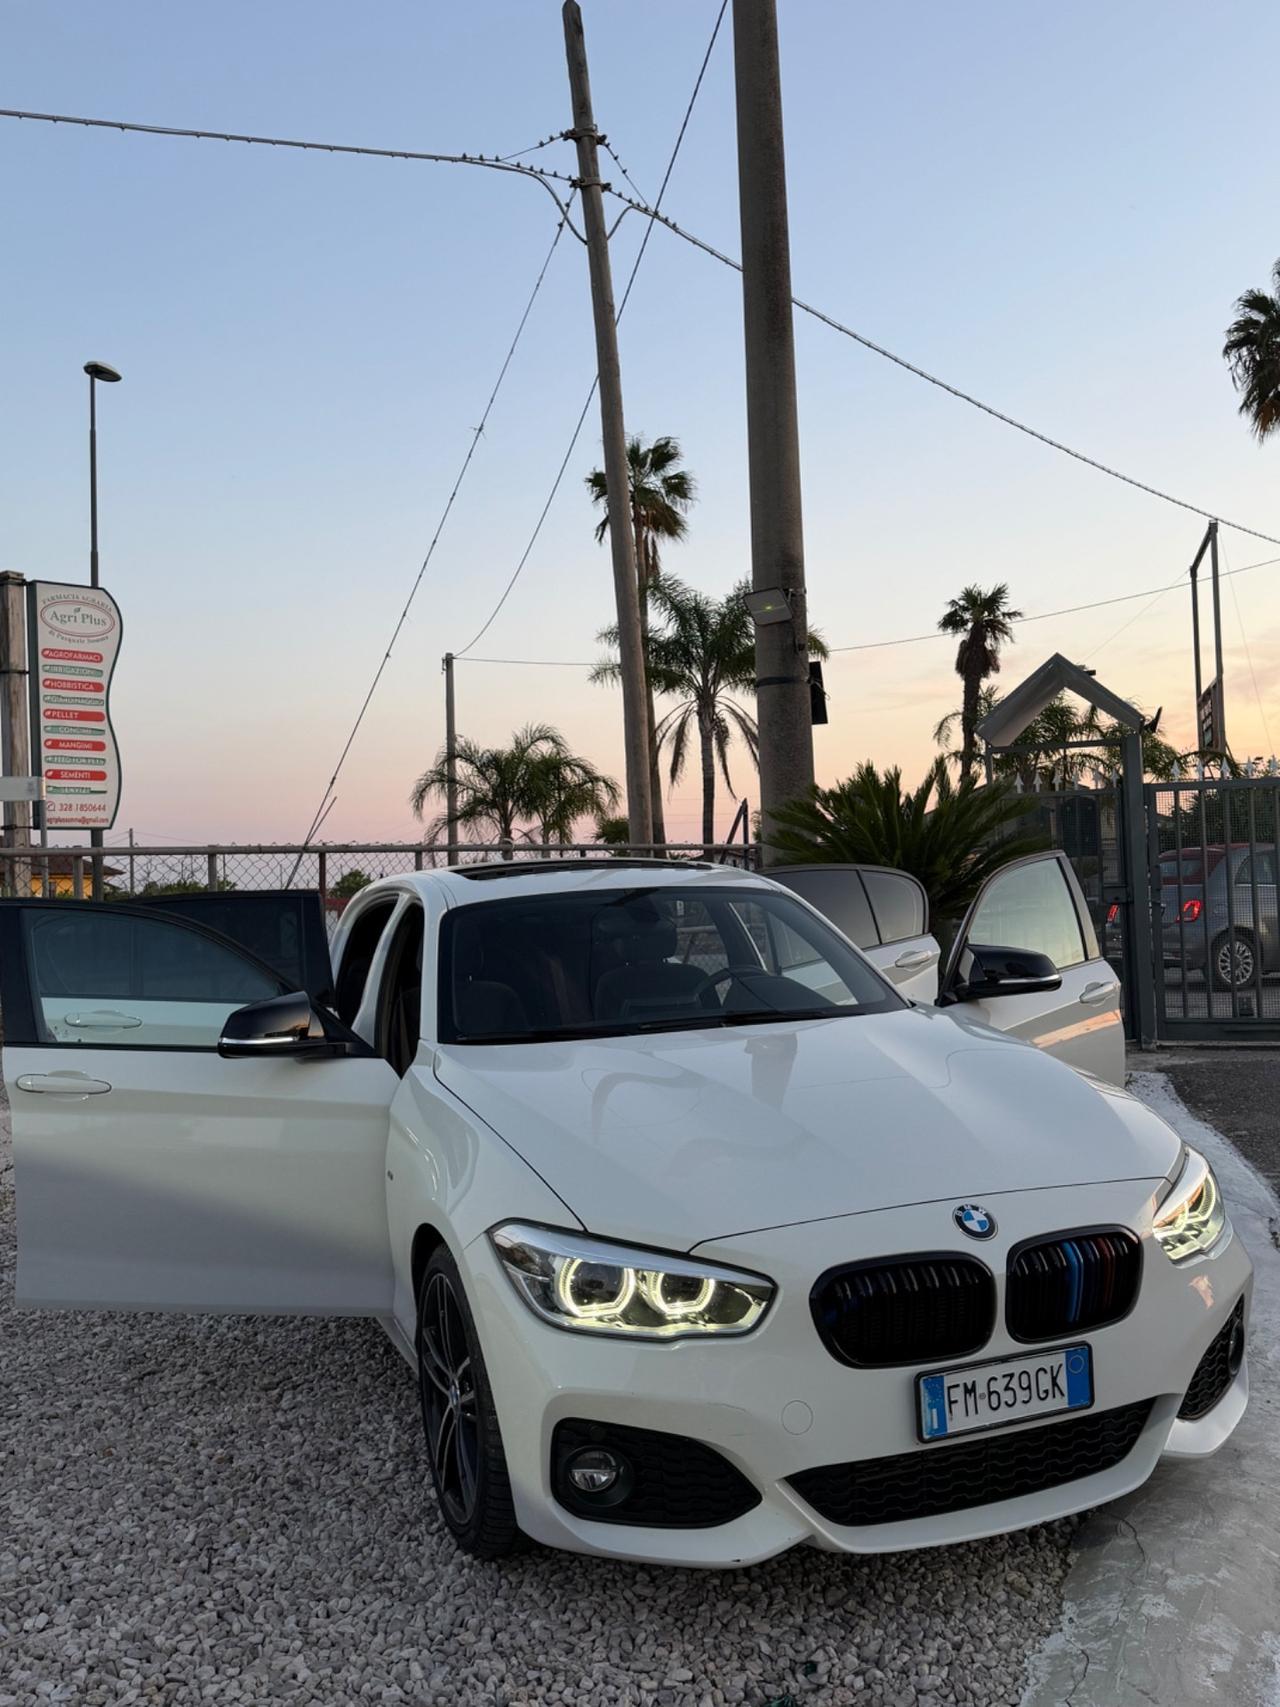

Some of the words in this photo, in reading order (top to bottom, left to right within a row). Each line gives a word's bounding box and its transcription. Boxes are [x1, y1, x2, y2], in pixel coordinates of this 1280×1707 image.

[49, 608, 78, 625] Agri
[81, 613, 107, 627] Plus
[50, 681, 94, 690] HOBBISTICA
[52, 710, 80, 719] PELLET
[59, 742, 93, 750] MANGIMI
[60, 771, 91, 779] SEMENTI
[59, 803, 73, 812] 328
[955, 1203, 986, 1217] BMW
